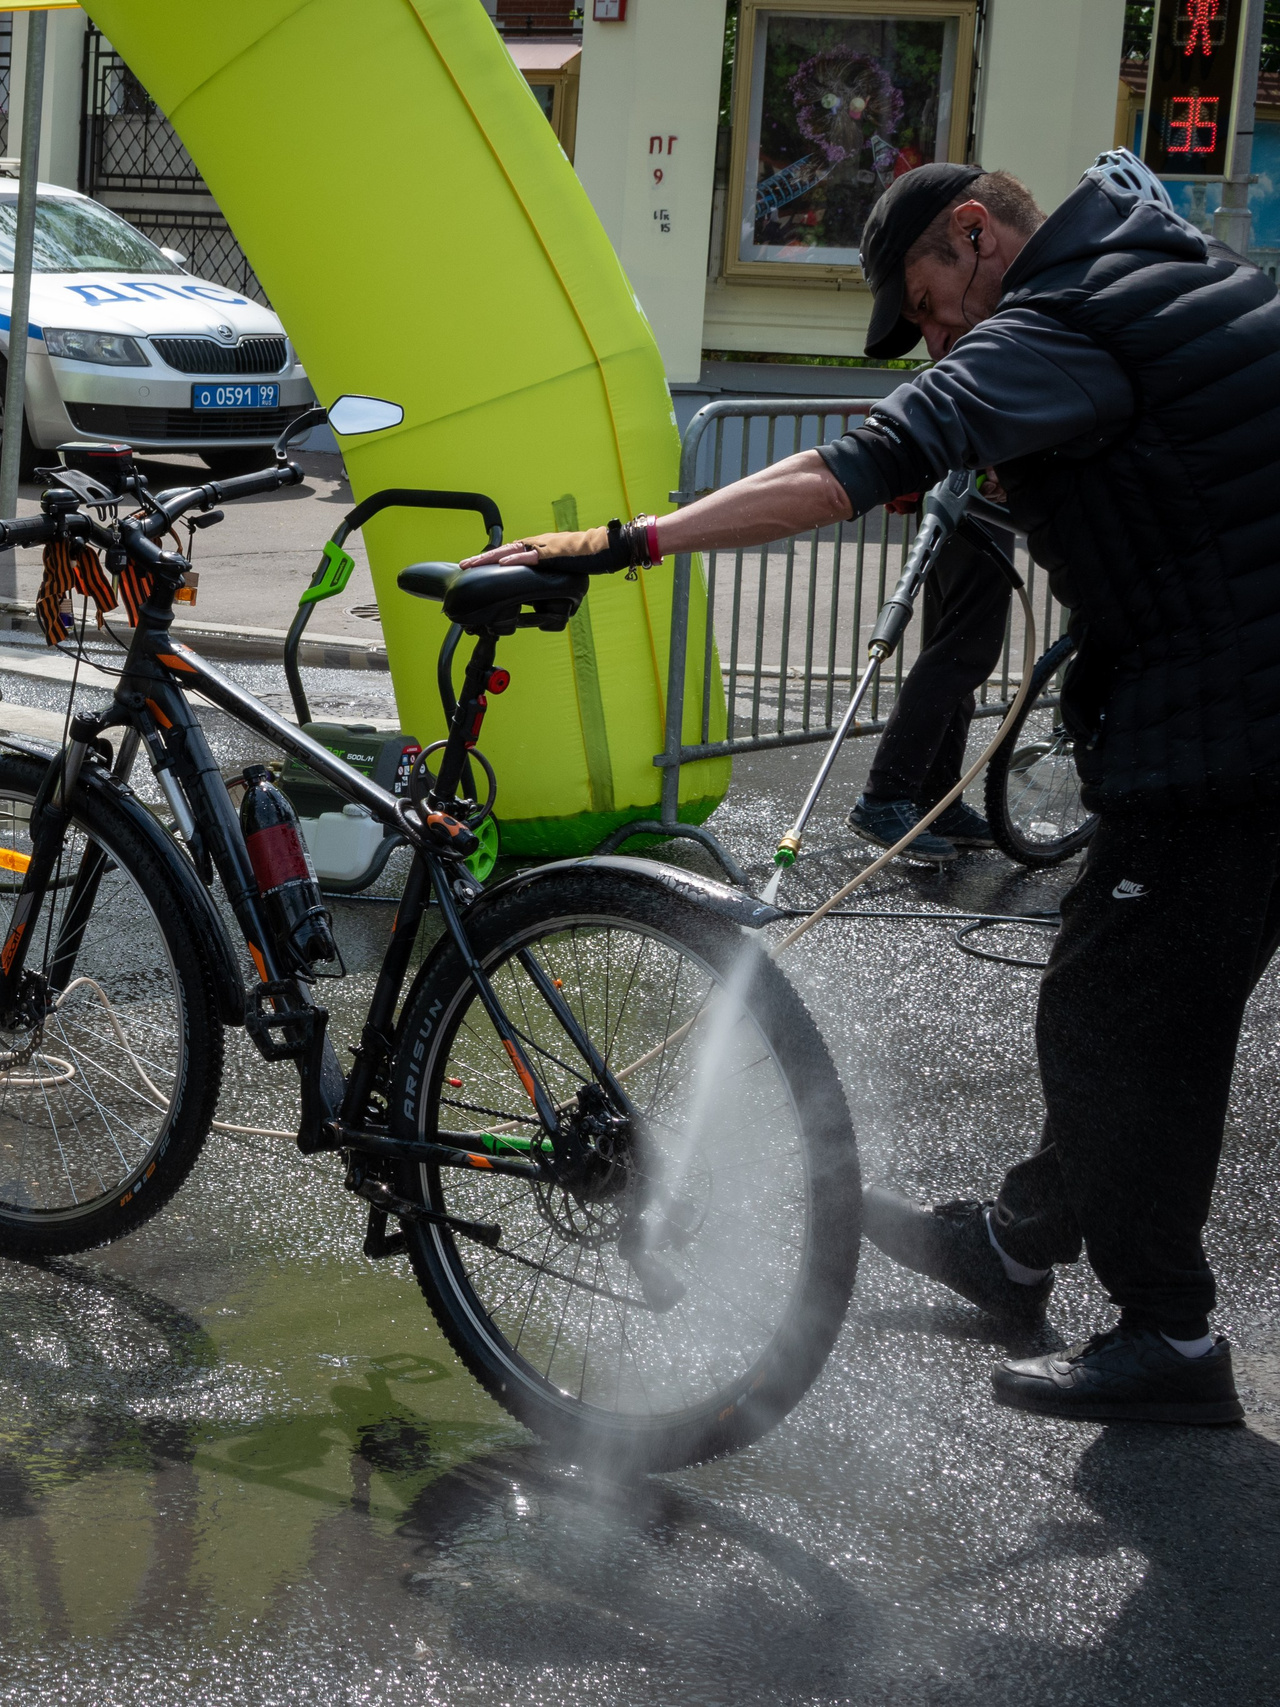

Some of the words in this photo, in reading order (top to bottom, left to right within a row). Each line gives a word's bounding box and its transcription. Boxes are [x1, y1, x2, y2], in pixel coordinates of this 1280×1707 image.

[1167, 96, 1219, 152] 35
[653, 168, 664, 185] 9
[63, 282, 248, 307] ДПС
[216, 387, 252, 406] 0591
[260, 386, 274, 400] 99
[346, 753, 375, 762] 500L/H
[1117, 878, 1144, 895] NIKE
[404, 998, 444, 1121] ARISUN
